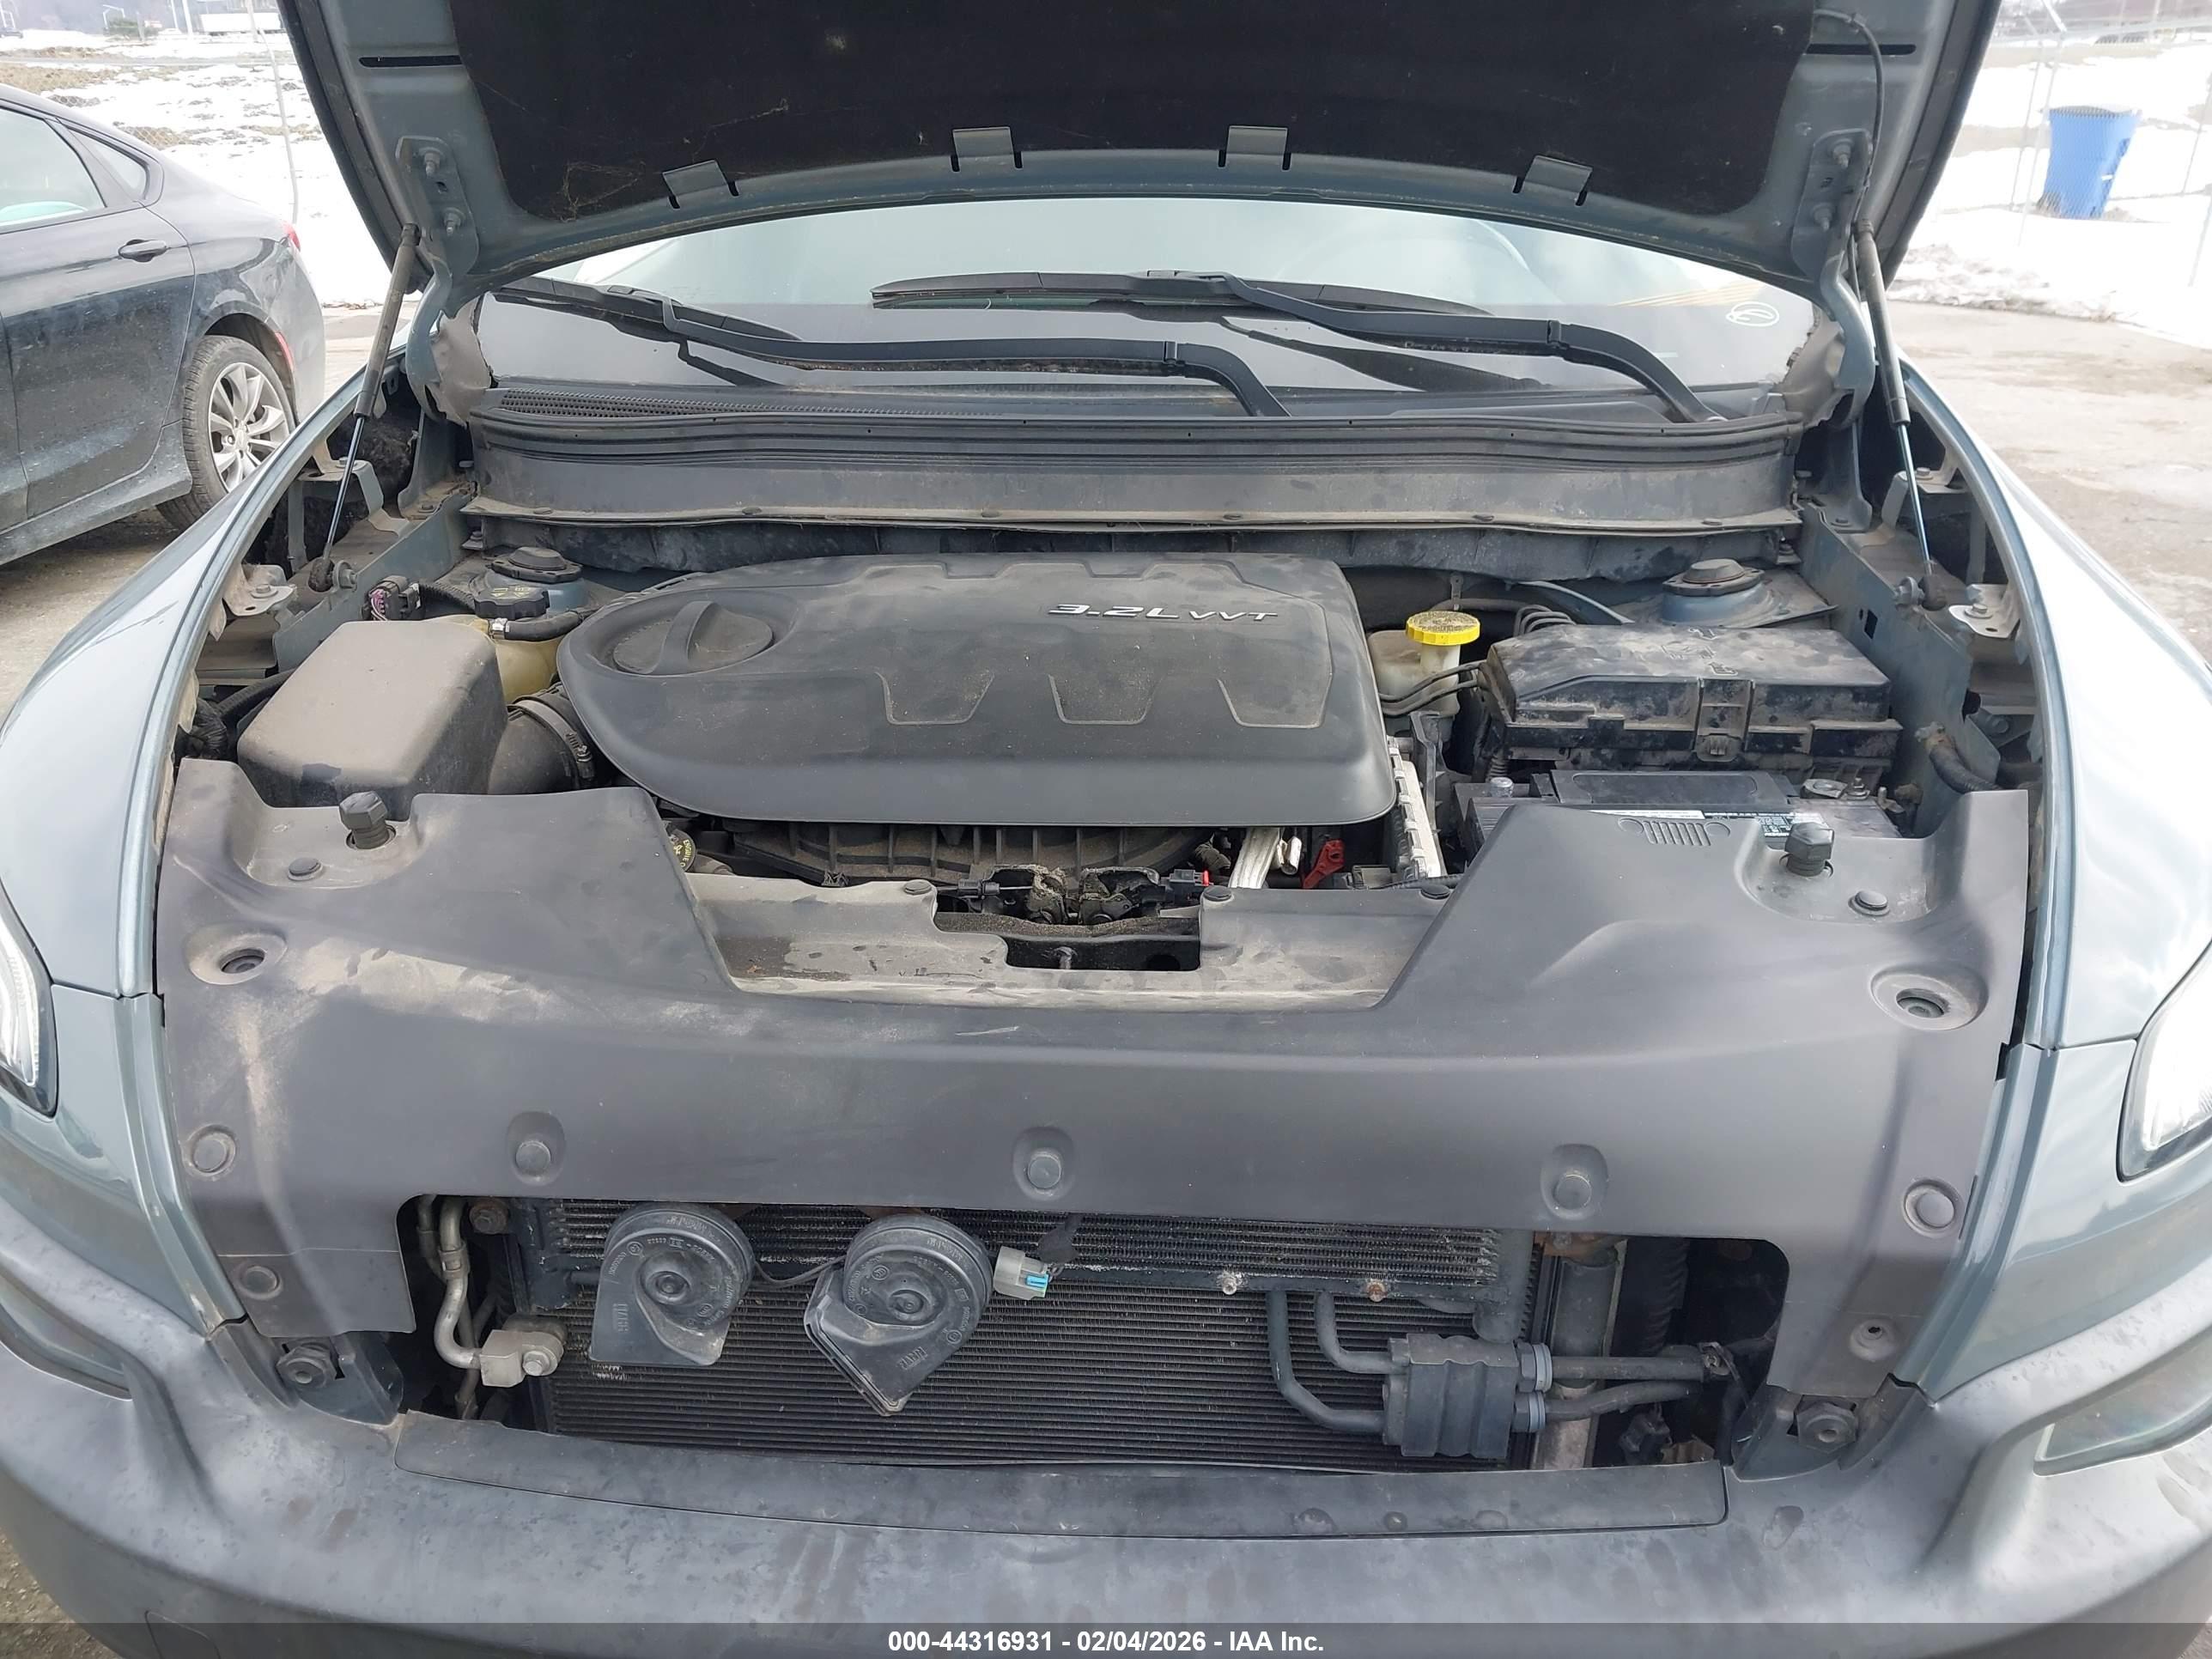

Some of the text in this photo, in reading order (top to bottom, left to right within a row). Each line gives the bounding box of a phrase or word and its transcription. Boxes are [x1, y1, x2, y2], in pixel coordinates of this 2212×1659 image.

[1048, 604, 1279, 622] 3.2L VVT
[683, 839, 692, 861] ENGINE
